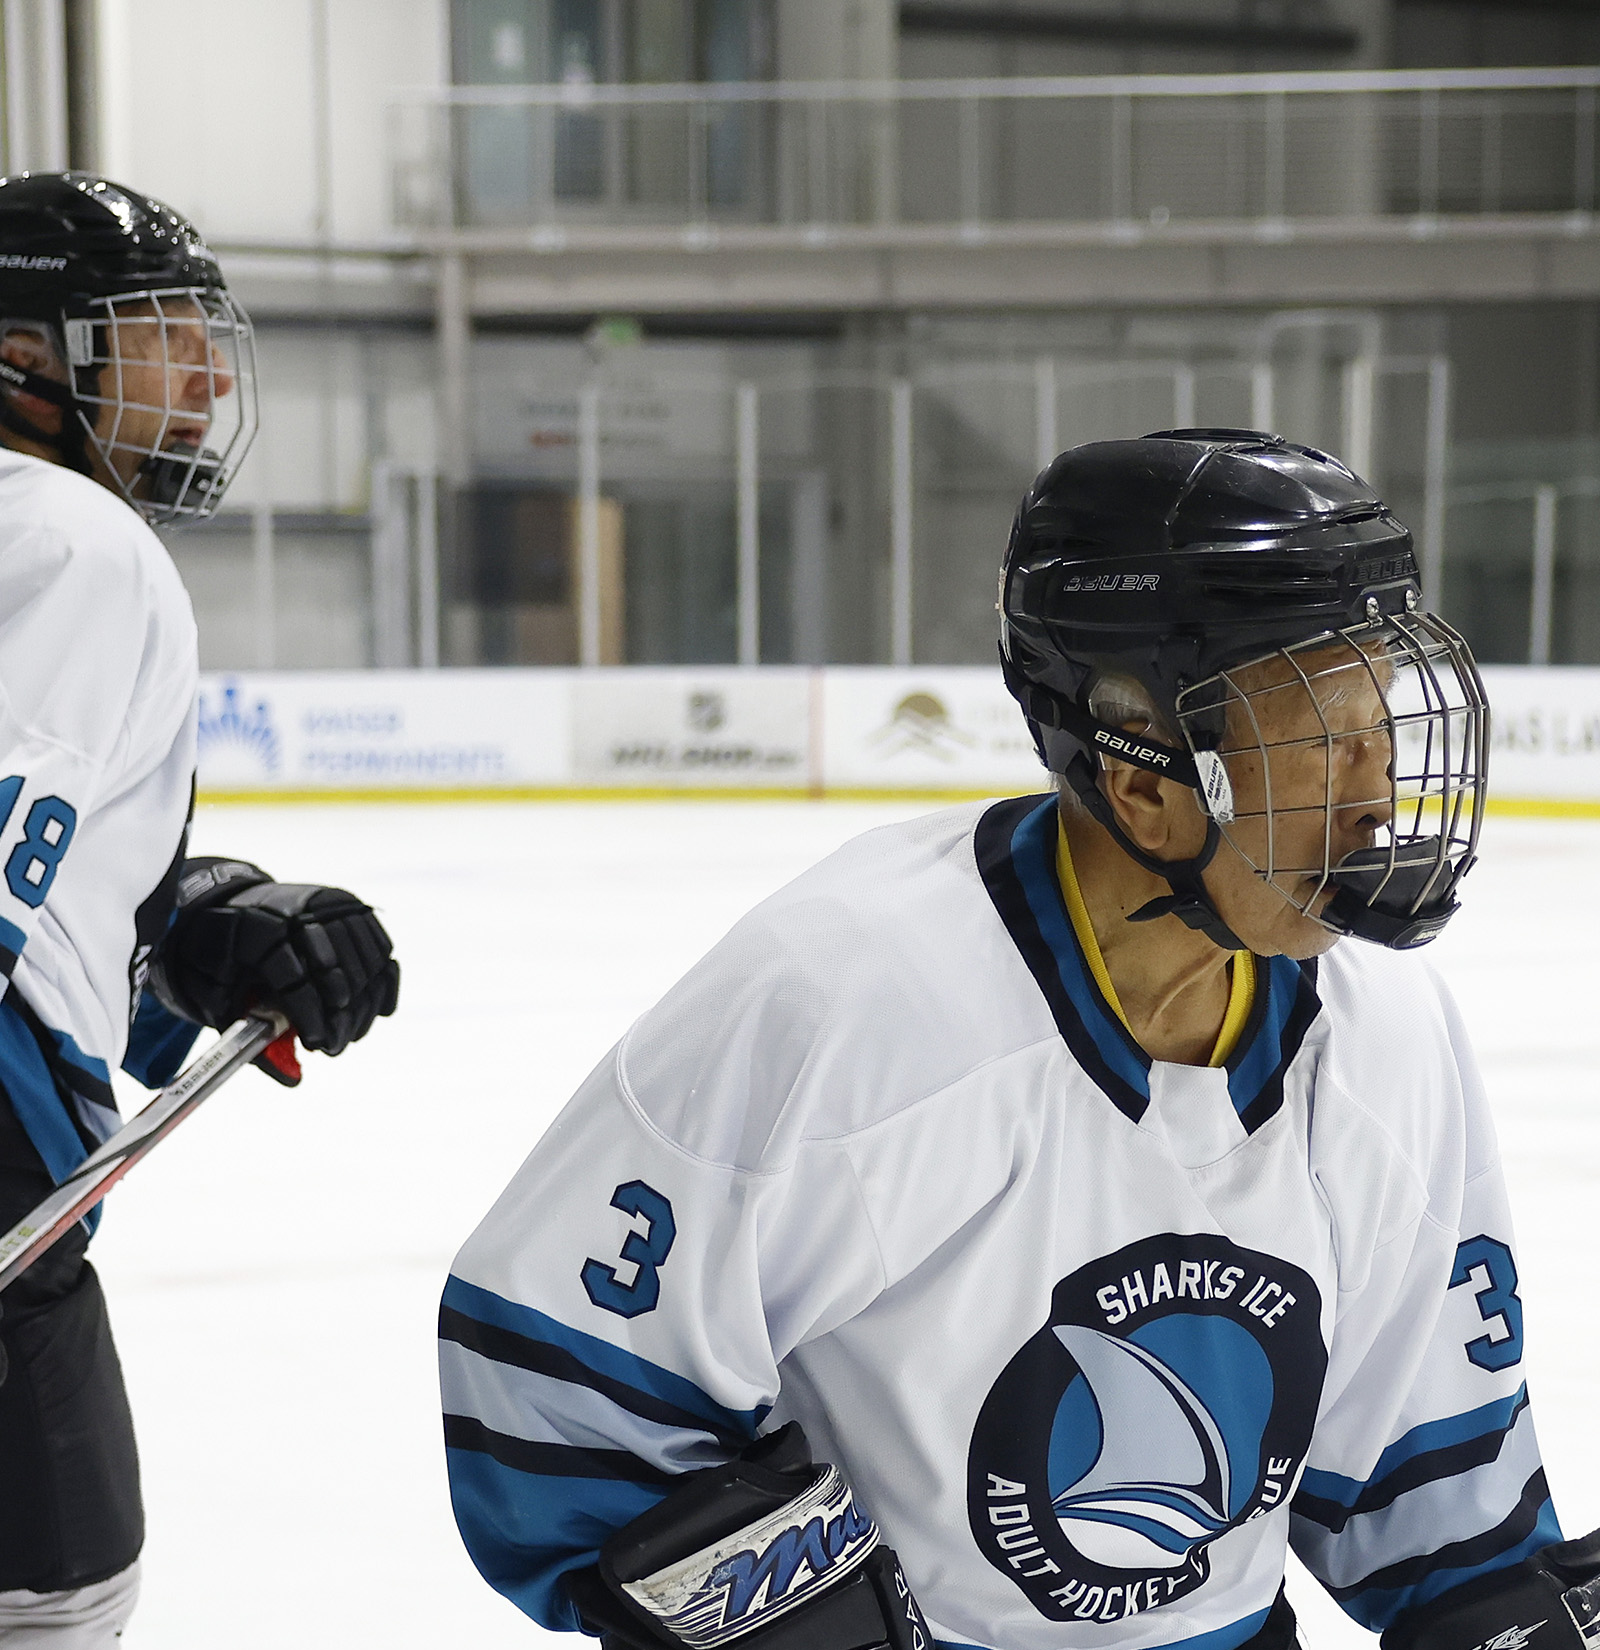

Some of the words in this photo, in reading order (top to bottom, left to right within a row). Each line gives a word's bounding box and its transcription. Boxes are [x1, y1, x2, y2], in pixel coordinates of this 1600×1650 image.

[1063, 573, 1161, 592] BAUER
[1094, 728, 1172, 769] BAUER
[580, 1179, 677, 1320] 3
[1095, 1259, 1245, 1325] SHARKS
[1239, 1274, 1297, 1329] ICE
[1447, 1233, 1524, 1374] 3
[985, 1472, 1062, 1579] ADULT
[1048, 1573, 1189, 1621] HOCKEY
